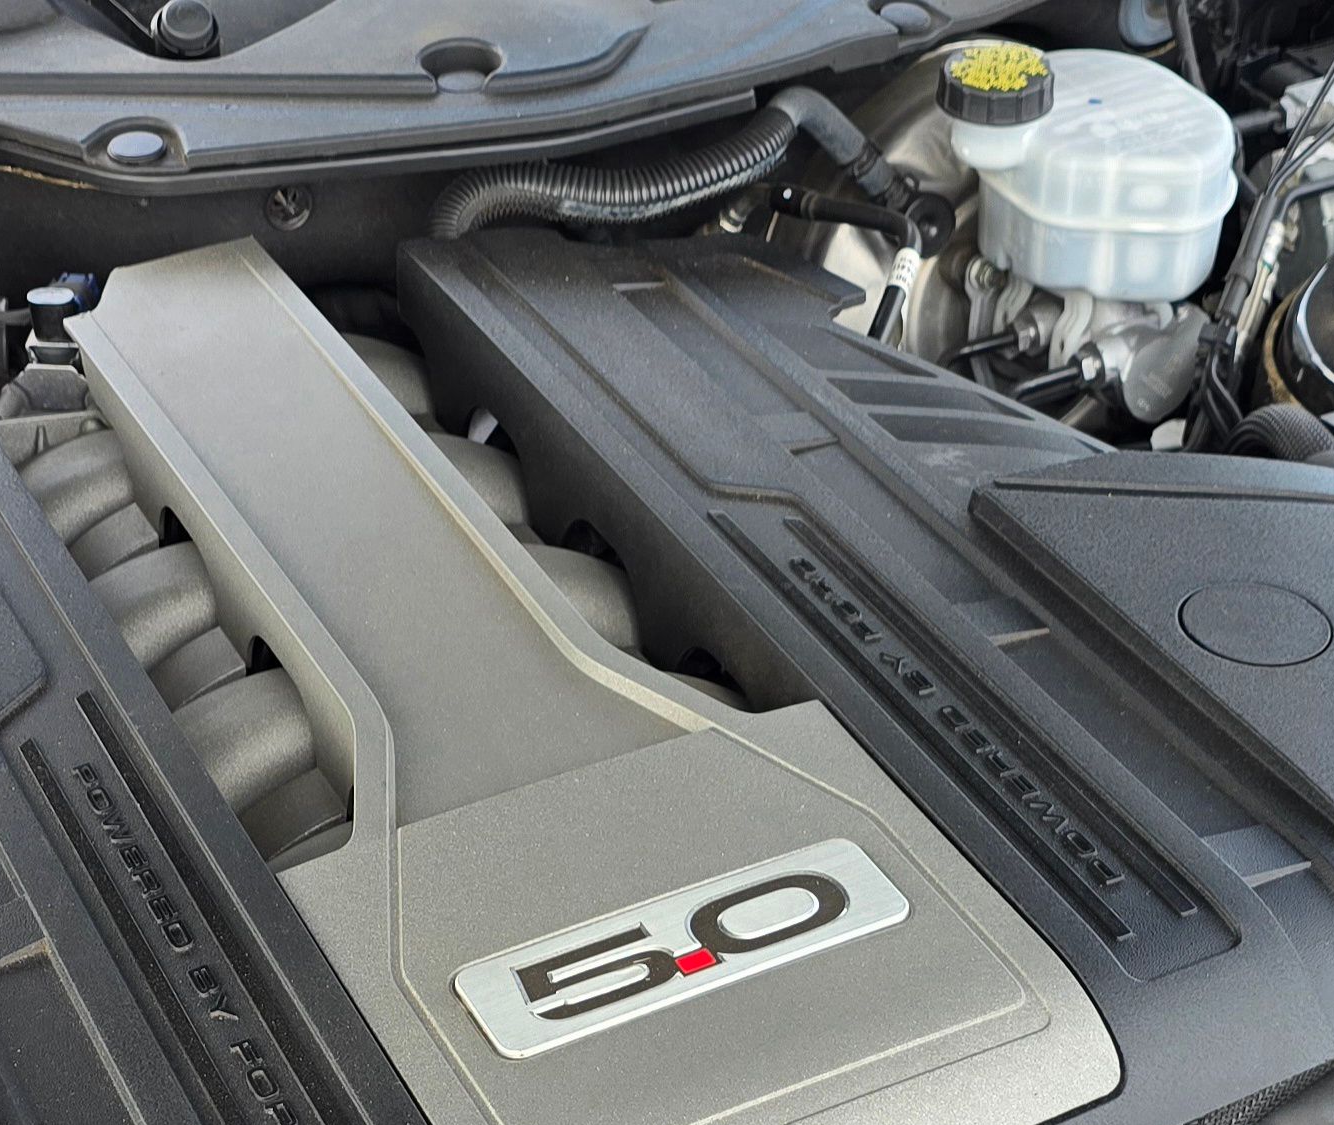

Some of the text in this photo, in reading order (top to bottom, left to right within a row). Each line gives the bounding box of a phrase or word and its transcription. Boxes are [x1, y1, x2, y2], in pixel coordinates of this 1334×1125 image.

[788, 555, 1125, 886] POWERED BY FORD
[72, 762, 194, 953] POWERED
[187, 965, 241, 1023] BY
[510, 870, 850, 1021] 5.0
